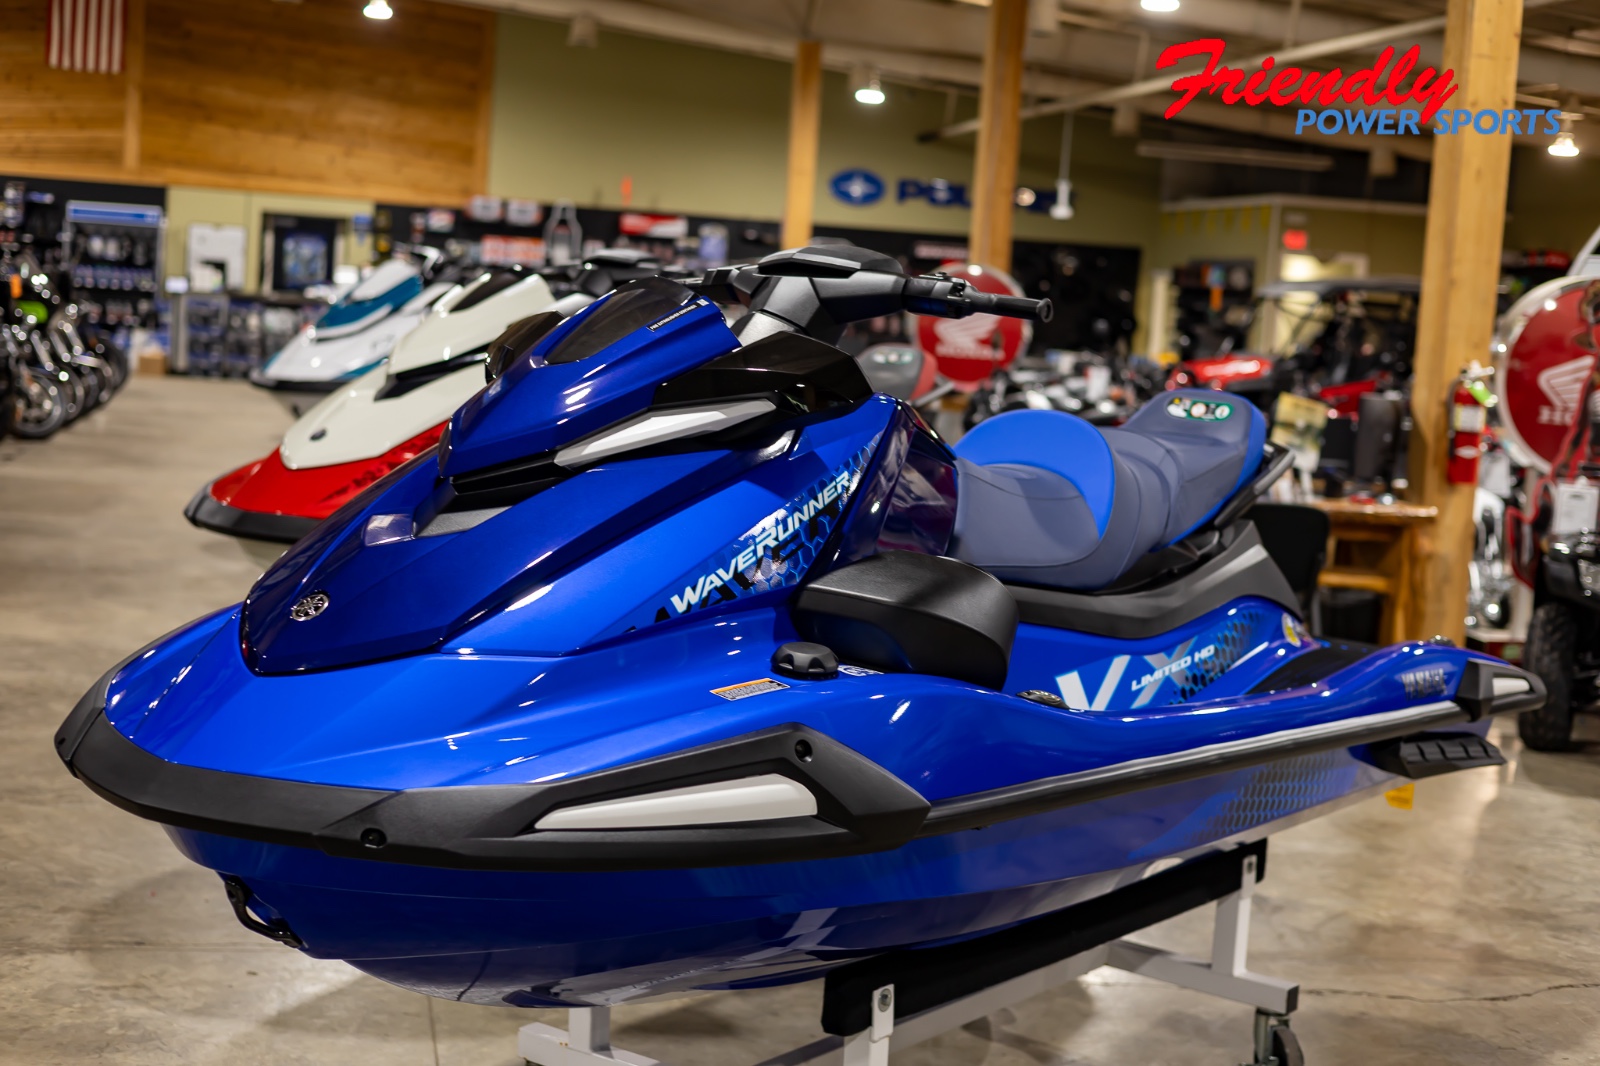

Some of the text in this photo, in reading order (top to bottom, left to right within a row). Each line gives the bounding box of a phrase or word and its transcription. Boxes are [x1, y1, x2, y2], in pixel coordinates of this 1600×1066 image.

[1054, 636, 1198, 711] VX
[1131, 644, 1216, 692] LIMITED HD
